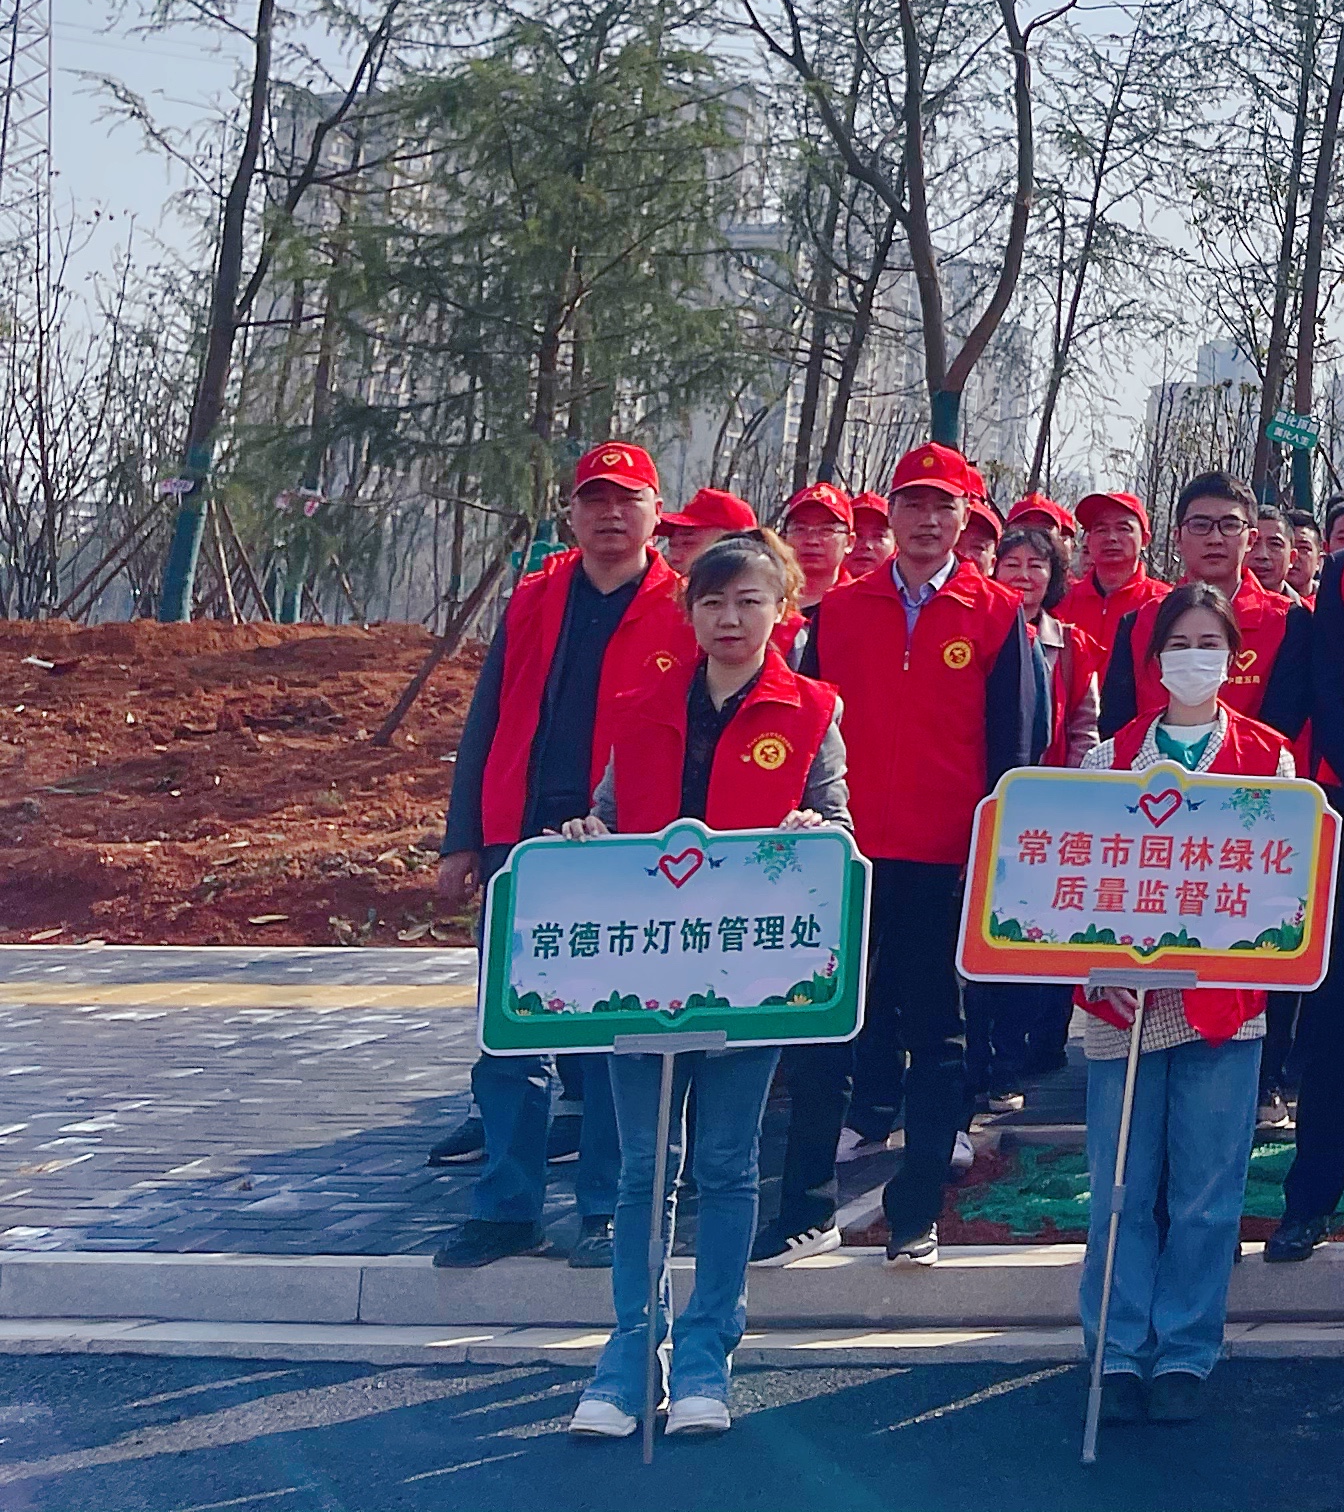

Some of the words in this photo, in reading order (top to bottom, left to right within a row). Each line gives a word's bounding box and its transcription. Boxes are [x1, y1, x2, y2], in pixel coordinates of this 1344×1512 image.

[1017, 829, 1294, 875] 常德市园林绿化
[1051, 876, 1251, 918] 质量监督站
[532, 913, 822, 960] 常德市灯饰管理处
